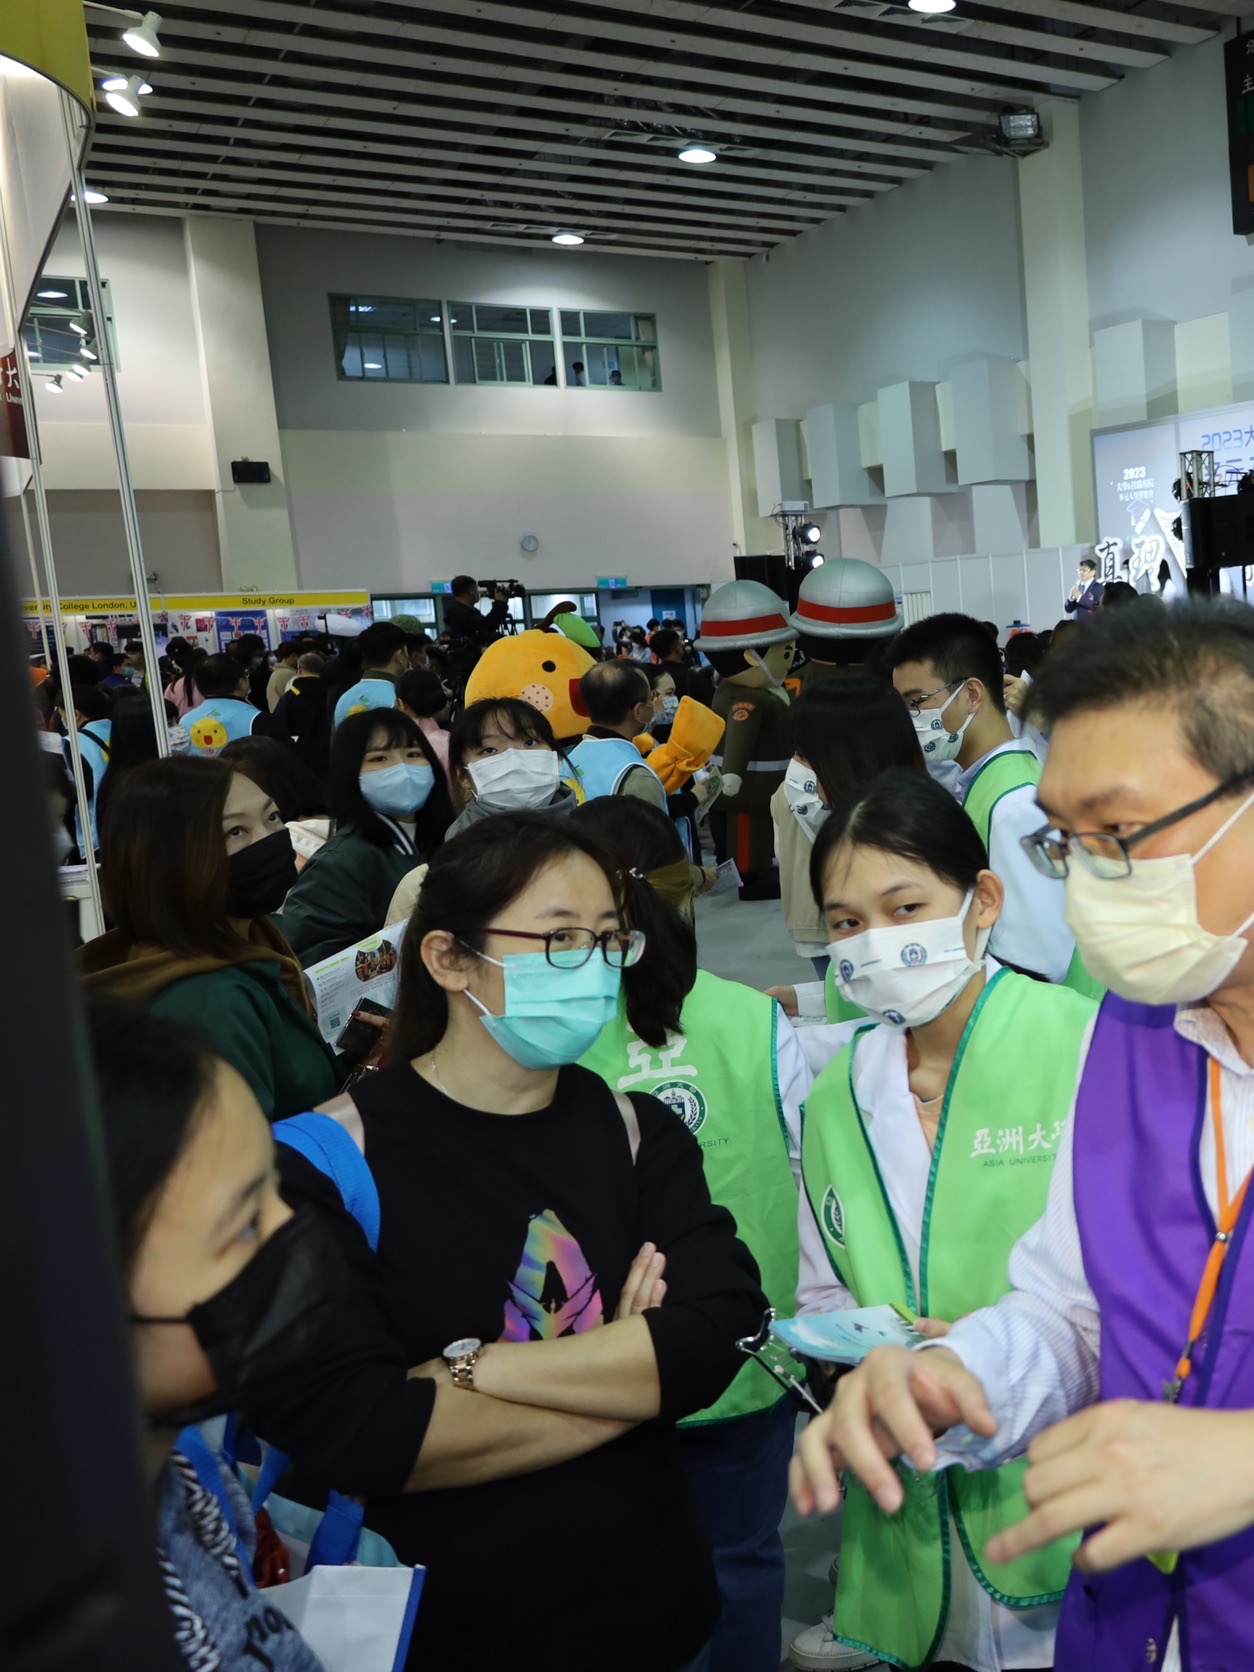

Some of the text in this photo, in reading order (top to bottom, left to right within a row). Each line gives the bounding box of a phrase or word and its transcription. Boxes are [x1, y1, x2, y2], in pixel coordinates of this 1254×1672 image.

[1123, 466, 1146, 480] 2023
[92, 600, 127, 610] London,
[242, 597, 295, 605] Study Group
[983, 1154, 1057, 1168] ASIA UNIVERSIT
